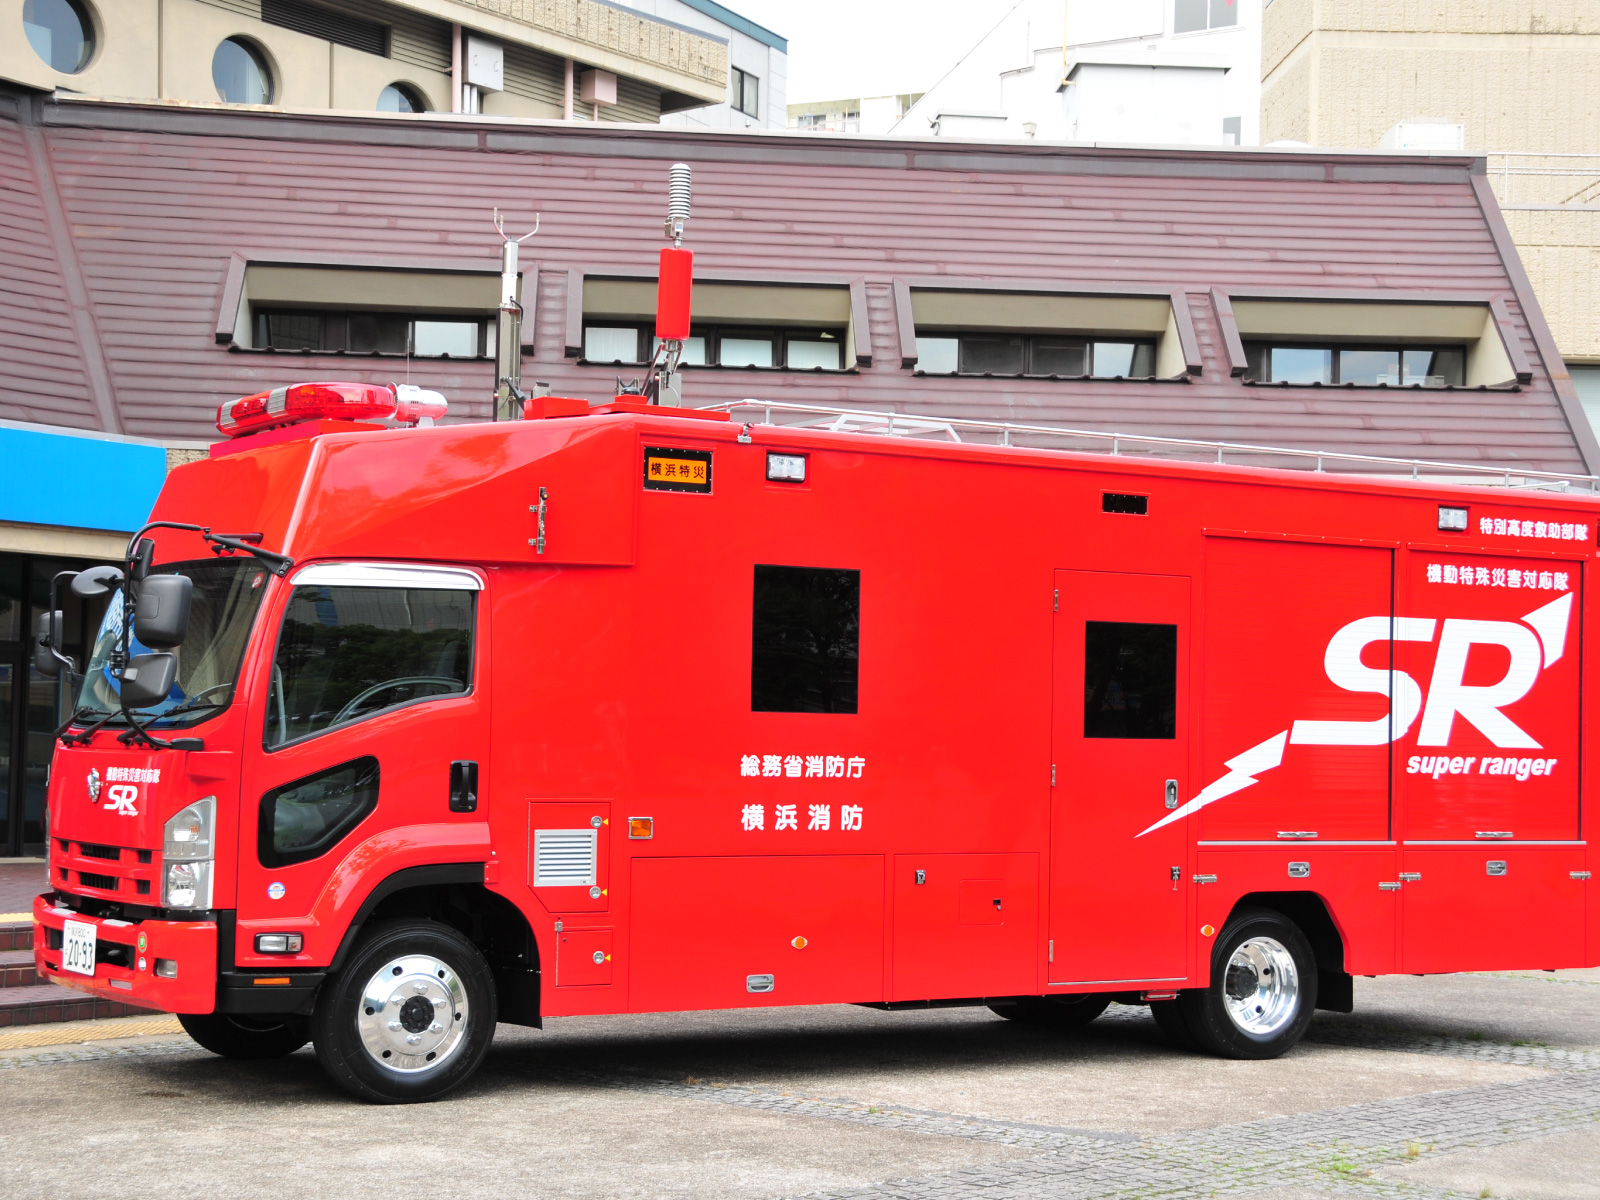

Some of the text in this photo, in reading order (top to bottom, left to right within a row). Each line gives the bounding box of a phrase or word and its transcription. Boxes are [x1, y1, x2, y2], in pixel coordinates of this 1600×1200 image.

[651, 462, 704, 479] 横浜特災
[1479, 516, 1589, 541] 特別高度救助部隊
[1426, 563, 1570, 591] 機動特殊災害対応隊
[1289, 616, 1544, 749] SR
[740, 754, 866, 778] 総務省消防庁
[1406, 755, 1558, 782] super ranger
[103, 784, 139, 812] SR
[740, 803, 864, 831] 横浜消防
